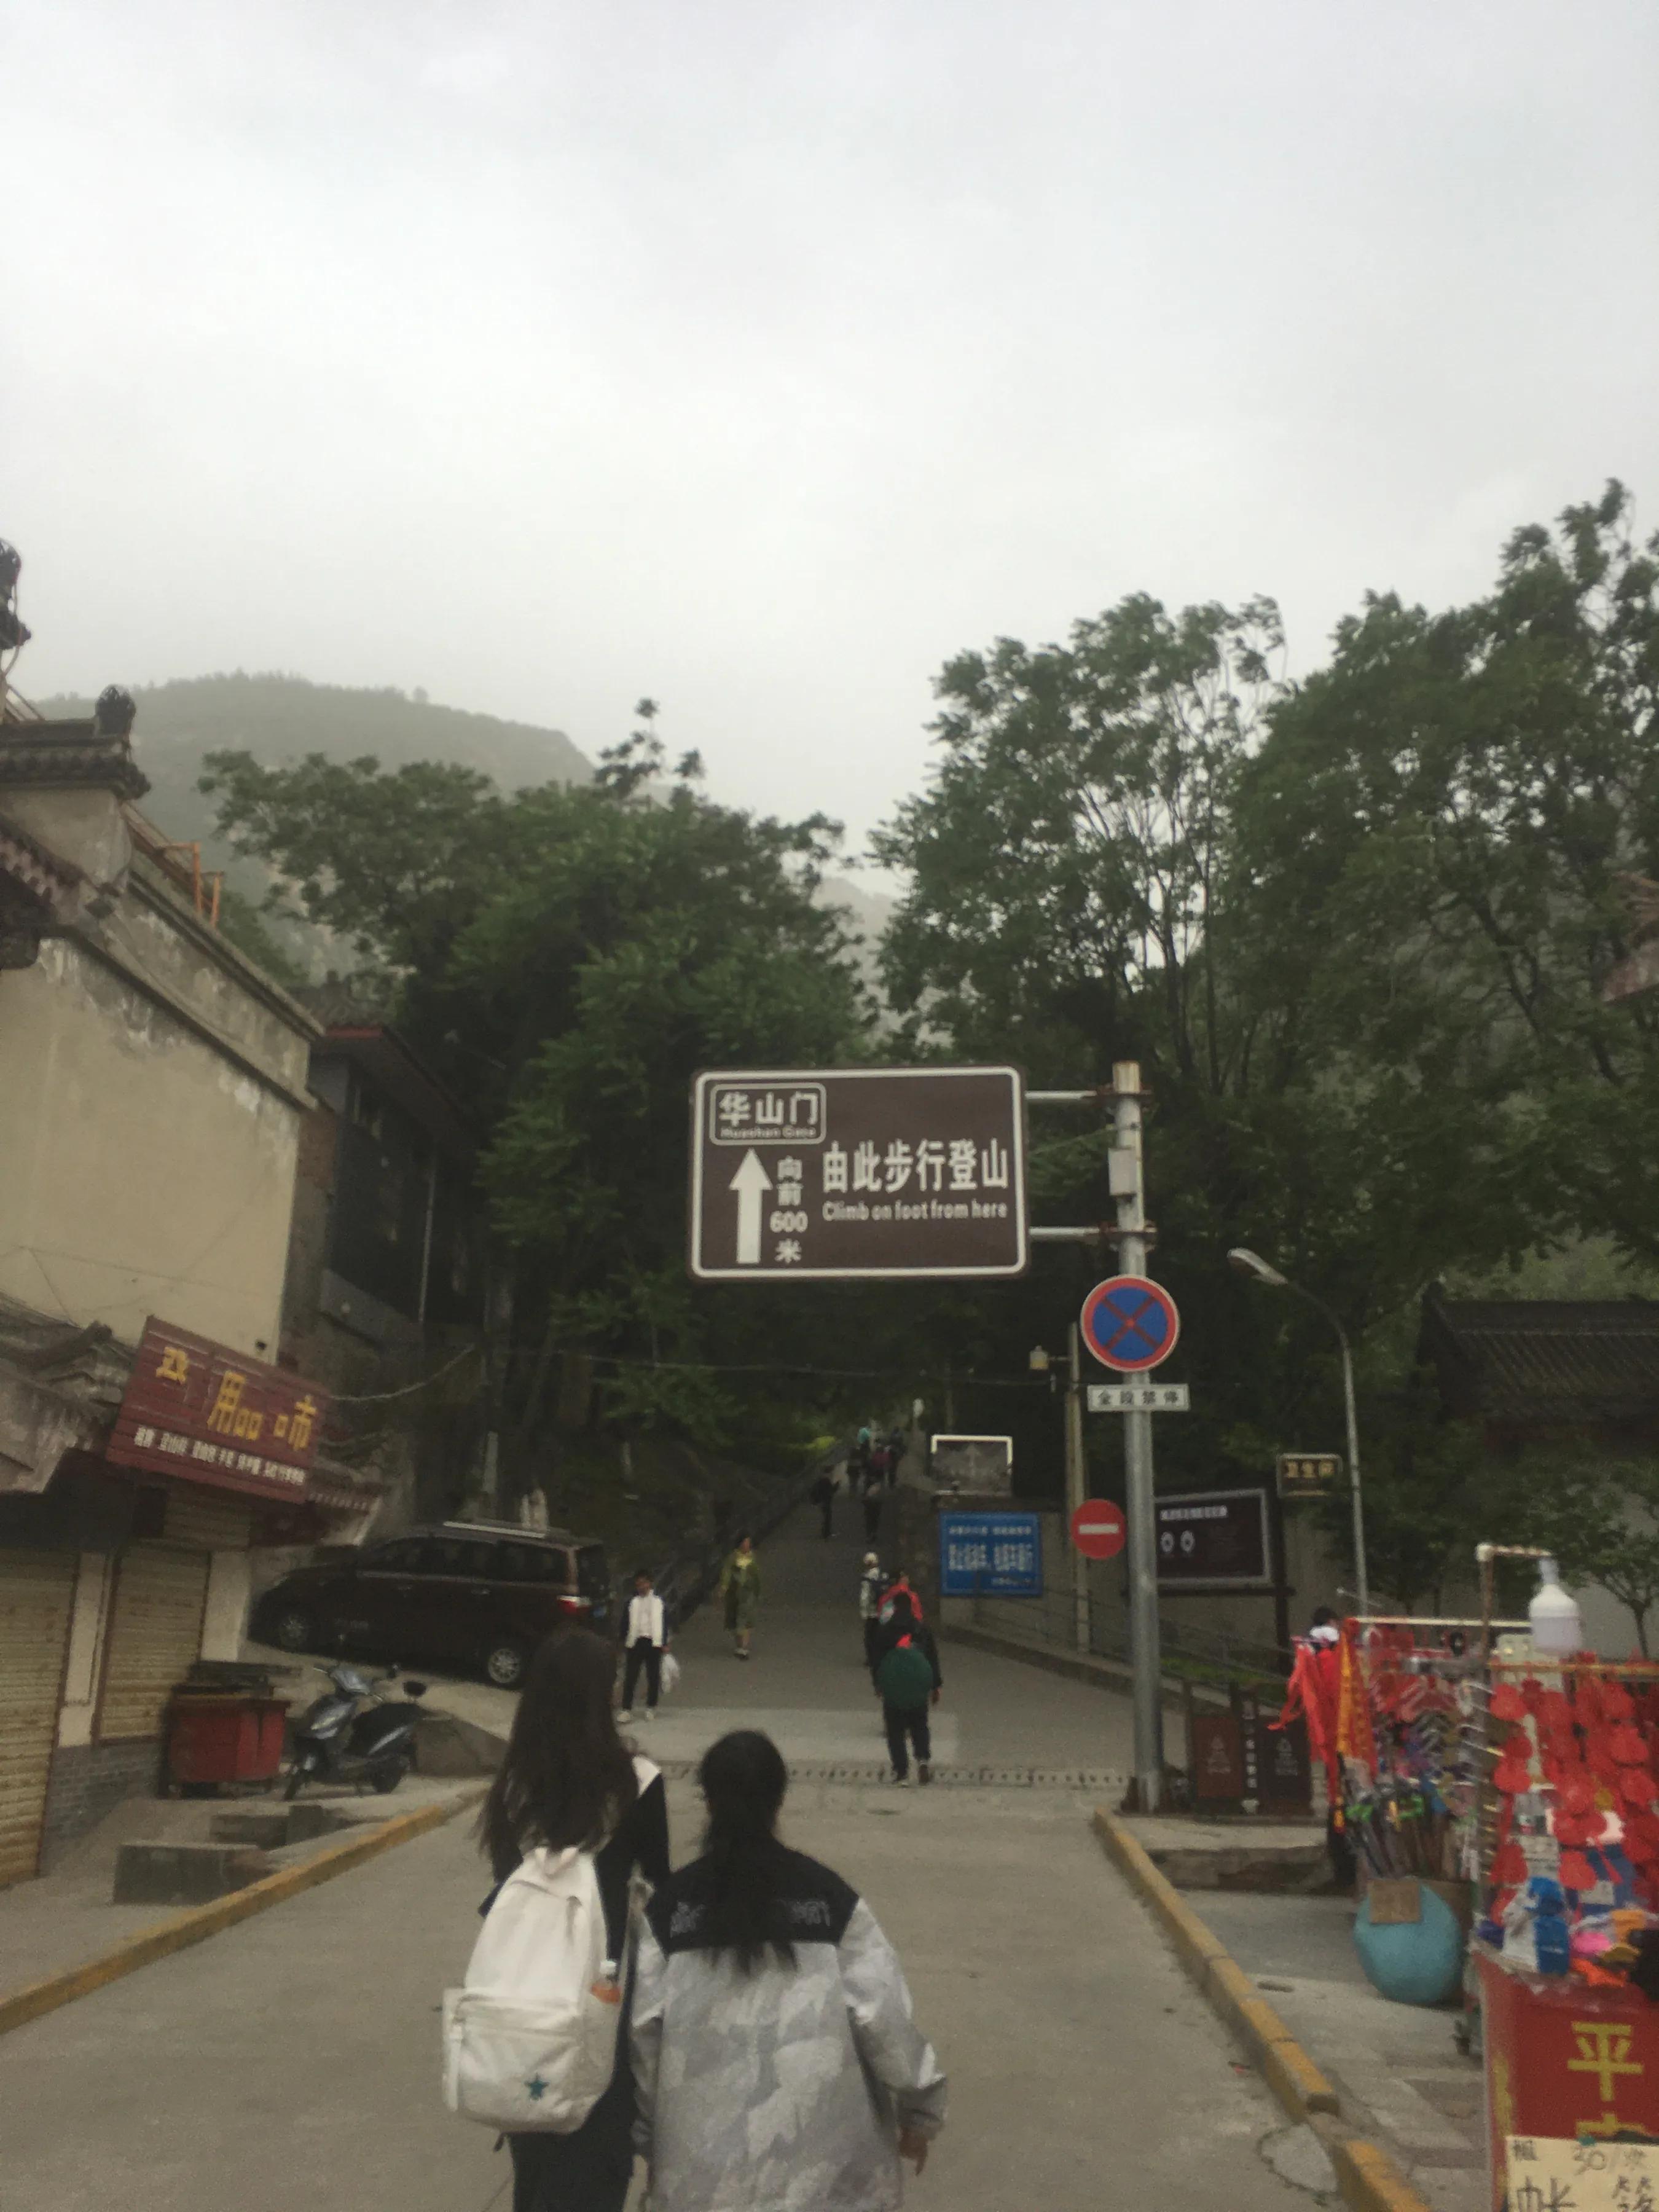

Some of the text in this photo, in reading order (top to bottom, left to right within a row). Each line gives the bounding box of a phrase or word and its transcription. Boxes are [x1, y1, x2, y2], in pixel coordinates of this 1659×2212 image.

[719, 1091, 818, 1126] 华山门
[823, 1137, 1008, 1193] 由此步行登山
[822, 1198, 1007, 1221] Climb on foot from here
